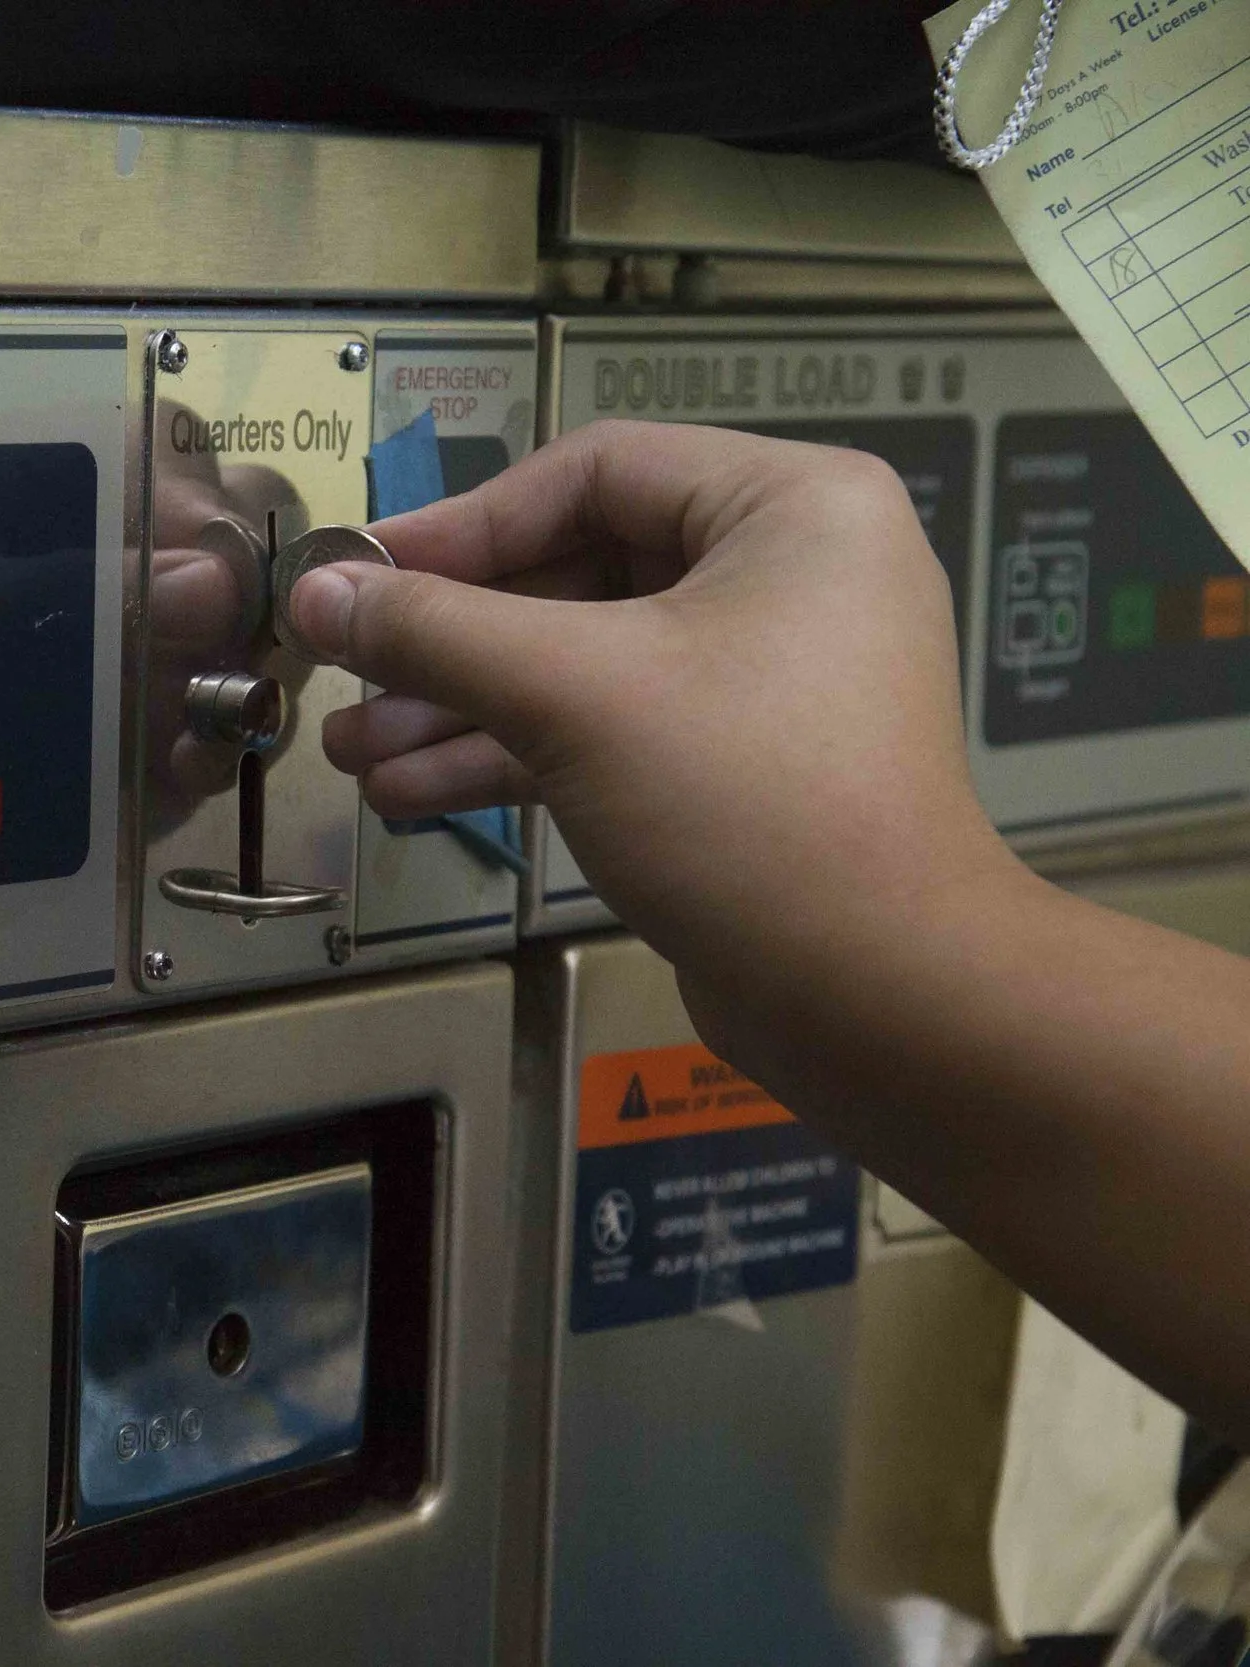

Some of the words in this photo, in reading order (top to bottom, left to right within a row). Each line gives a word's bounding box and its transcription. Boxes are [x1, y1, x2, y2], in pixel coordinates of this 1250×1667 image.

[1147, 1, 1207, 42] License
[1047, 78, 1076, 101] Days
[1078, 70, 1088, 82] A
[1088, 48, 1124, 74] Week
[1014, 115, 1055, 147] :00am
[1065, 83, 1110, 114] 8:00pm
[1026, 147, 1076, 183] Name
[1044, 197, 1073, 220] Tel
[395, 366, 512, 391] EMERGENCY
[594, 354, 759, 411] DOUBLE
[775, 352, 878, 408] LOAD
[430, 397, 479, 421] STOP
[171, 409, 286, 453] Quarters
[294, 409, 352, 462] Only
